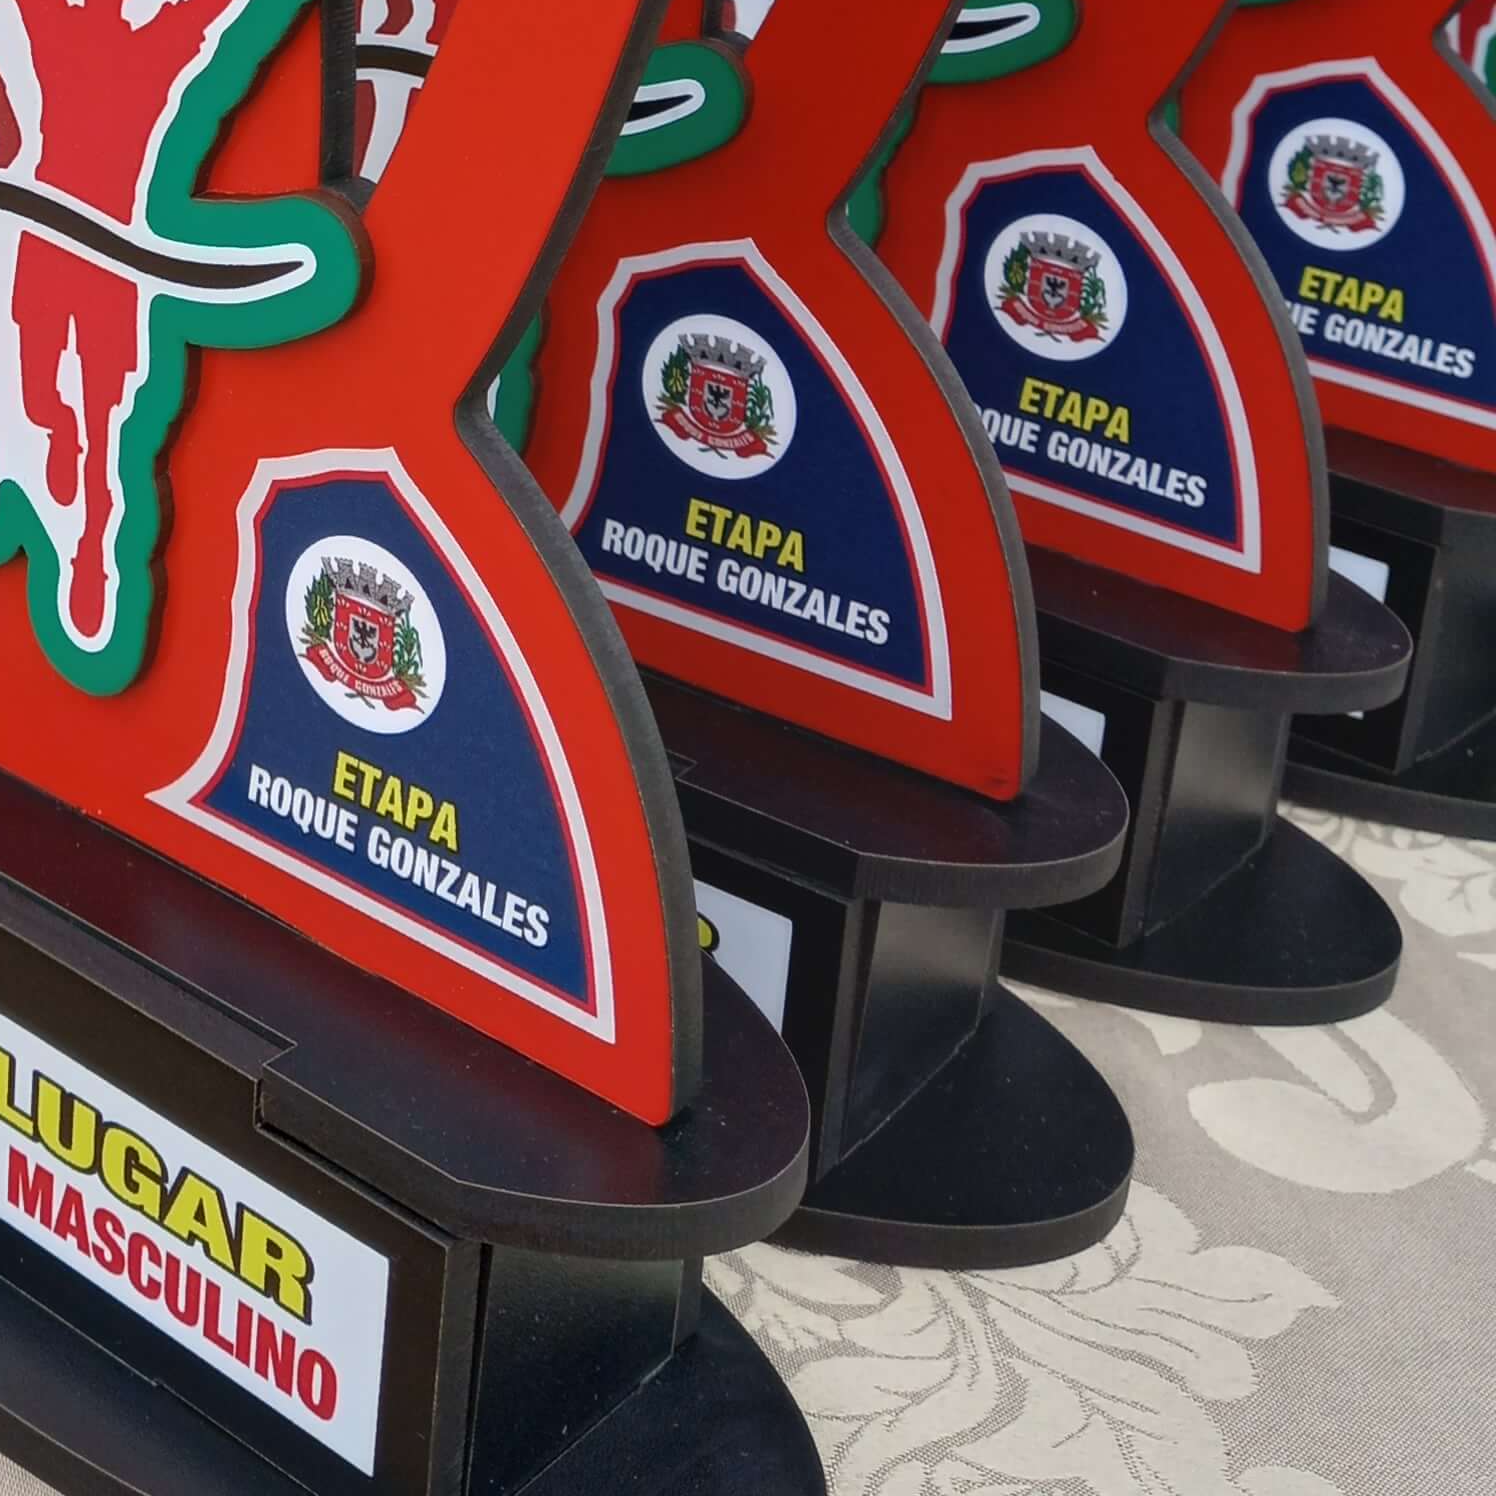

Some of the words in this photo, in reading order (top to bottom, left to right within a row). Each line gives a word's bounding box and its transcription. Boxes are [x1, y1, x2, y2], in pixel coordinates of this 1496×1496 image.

[1297, 264, 1406, 324] ETAPA
[1322, 311, 1477, 380] GONZALES
[974, 402, 1041, 455] QUE
[1046, 429, 1208, 508] GONZALES
[1017, 375, 1134, 445] ETAPA
[601, 517, 707, 584] ROQUE
[716, 558, 891, 647] GONZALES
[684, 496, 805, 574] ETAPA
[330, 748, 461, 854] ETAPA
[247, 762, 359, 854] ROQUE
[366, 824, 551, 950] GONZALES
[5, 1143, 340, 1424] MASCULINO
